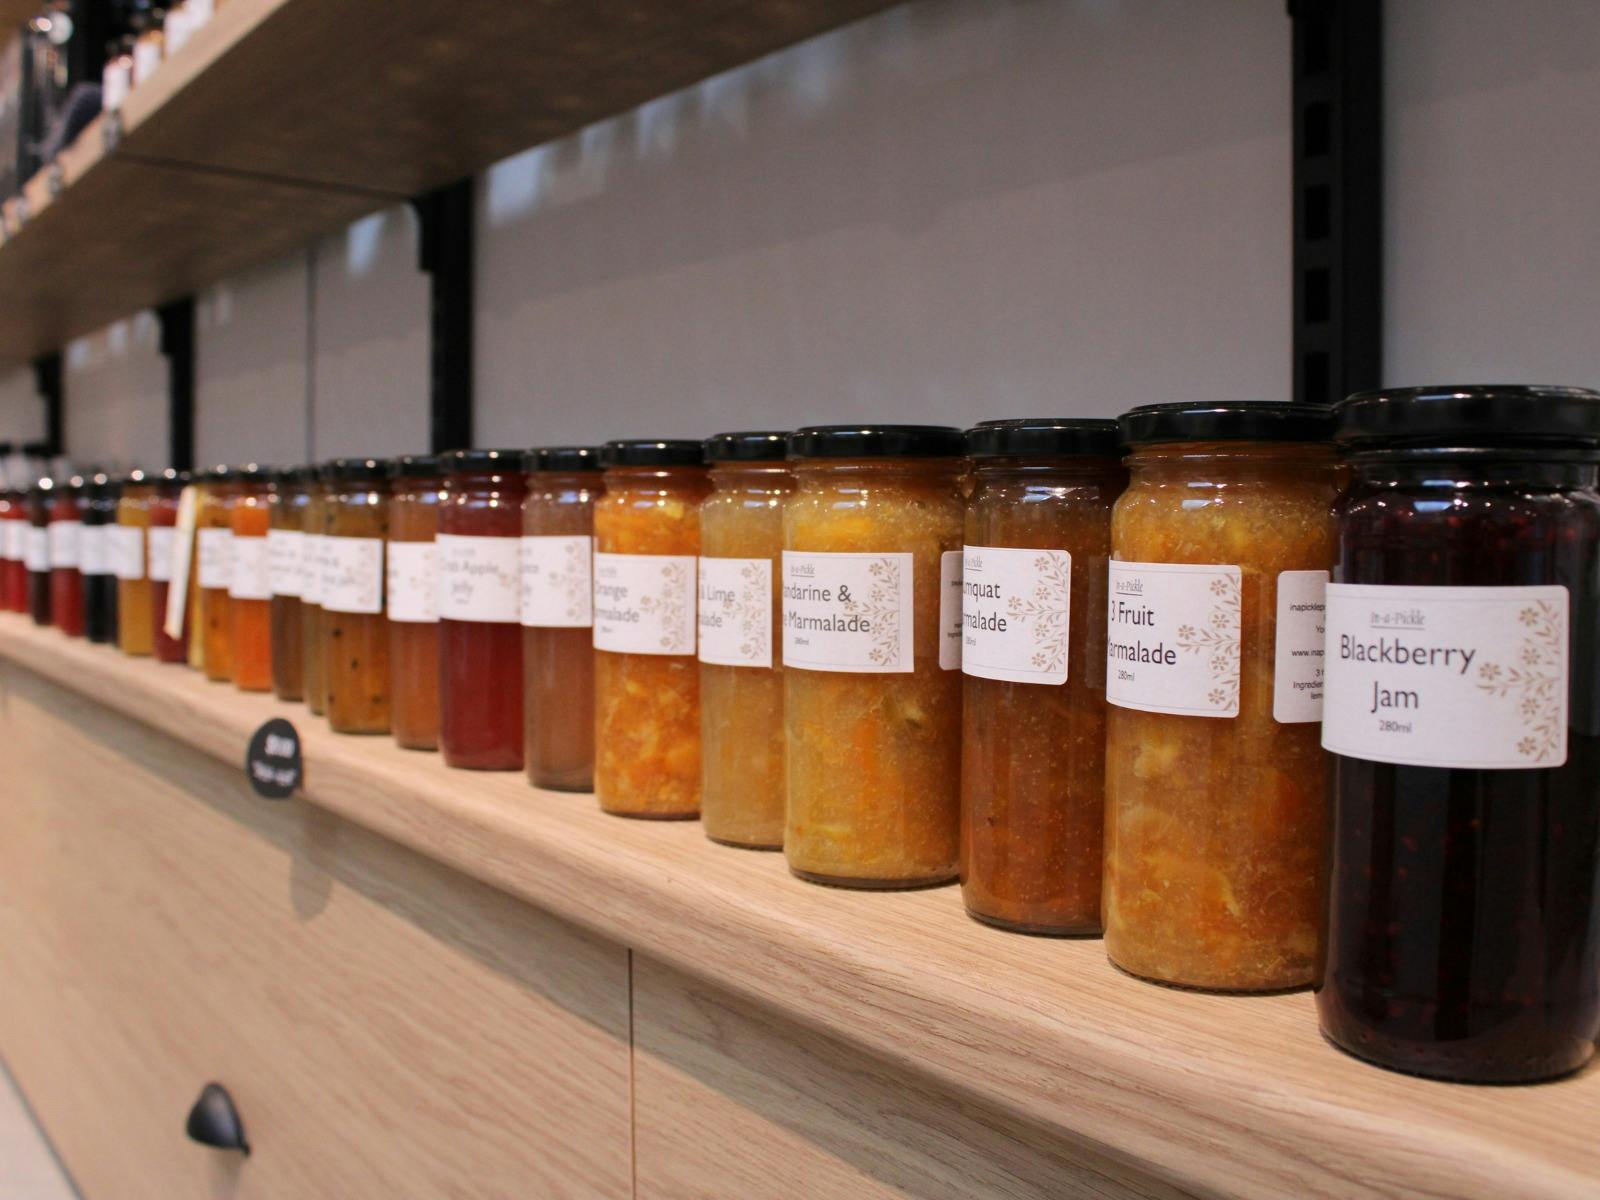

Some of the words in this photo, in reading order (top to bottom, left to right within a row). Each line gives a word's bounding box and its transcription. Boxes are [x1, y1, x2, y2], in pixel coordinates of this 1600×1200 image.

[707, 586, 736, 602] Lime
[837, 584, 852, 603] &
[1111, 600, 1116, 622] 3
[1118, 601, 1155, 627] Fruit
[1290, 603, 1326, 612] inapicklep
[788, 610, 871, 633] Marmalade
[1315, 625, 1325, 634] Yo
[1108, 636, 1177, 666] armalade
[1291, 649, 1325, 658] www.inap
[1340, 634, 1476, 675] Blackberry
[1117, 669, 1136, 682] 280ml
[1370, 680, 1419, 714] Jam
[1378, 720, 1413, 734] 280ml
